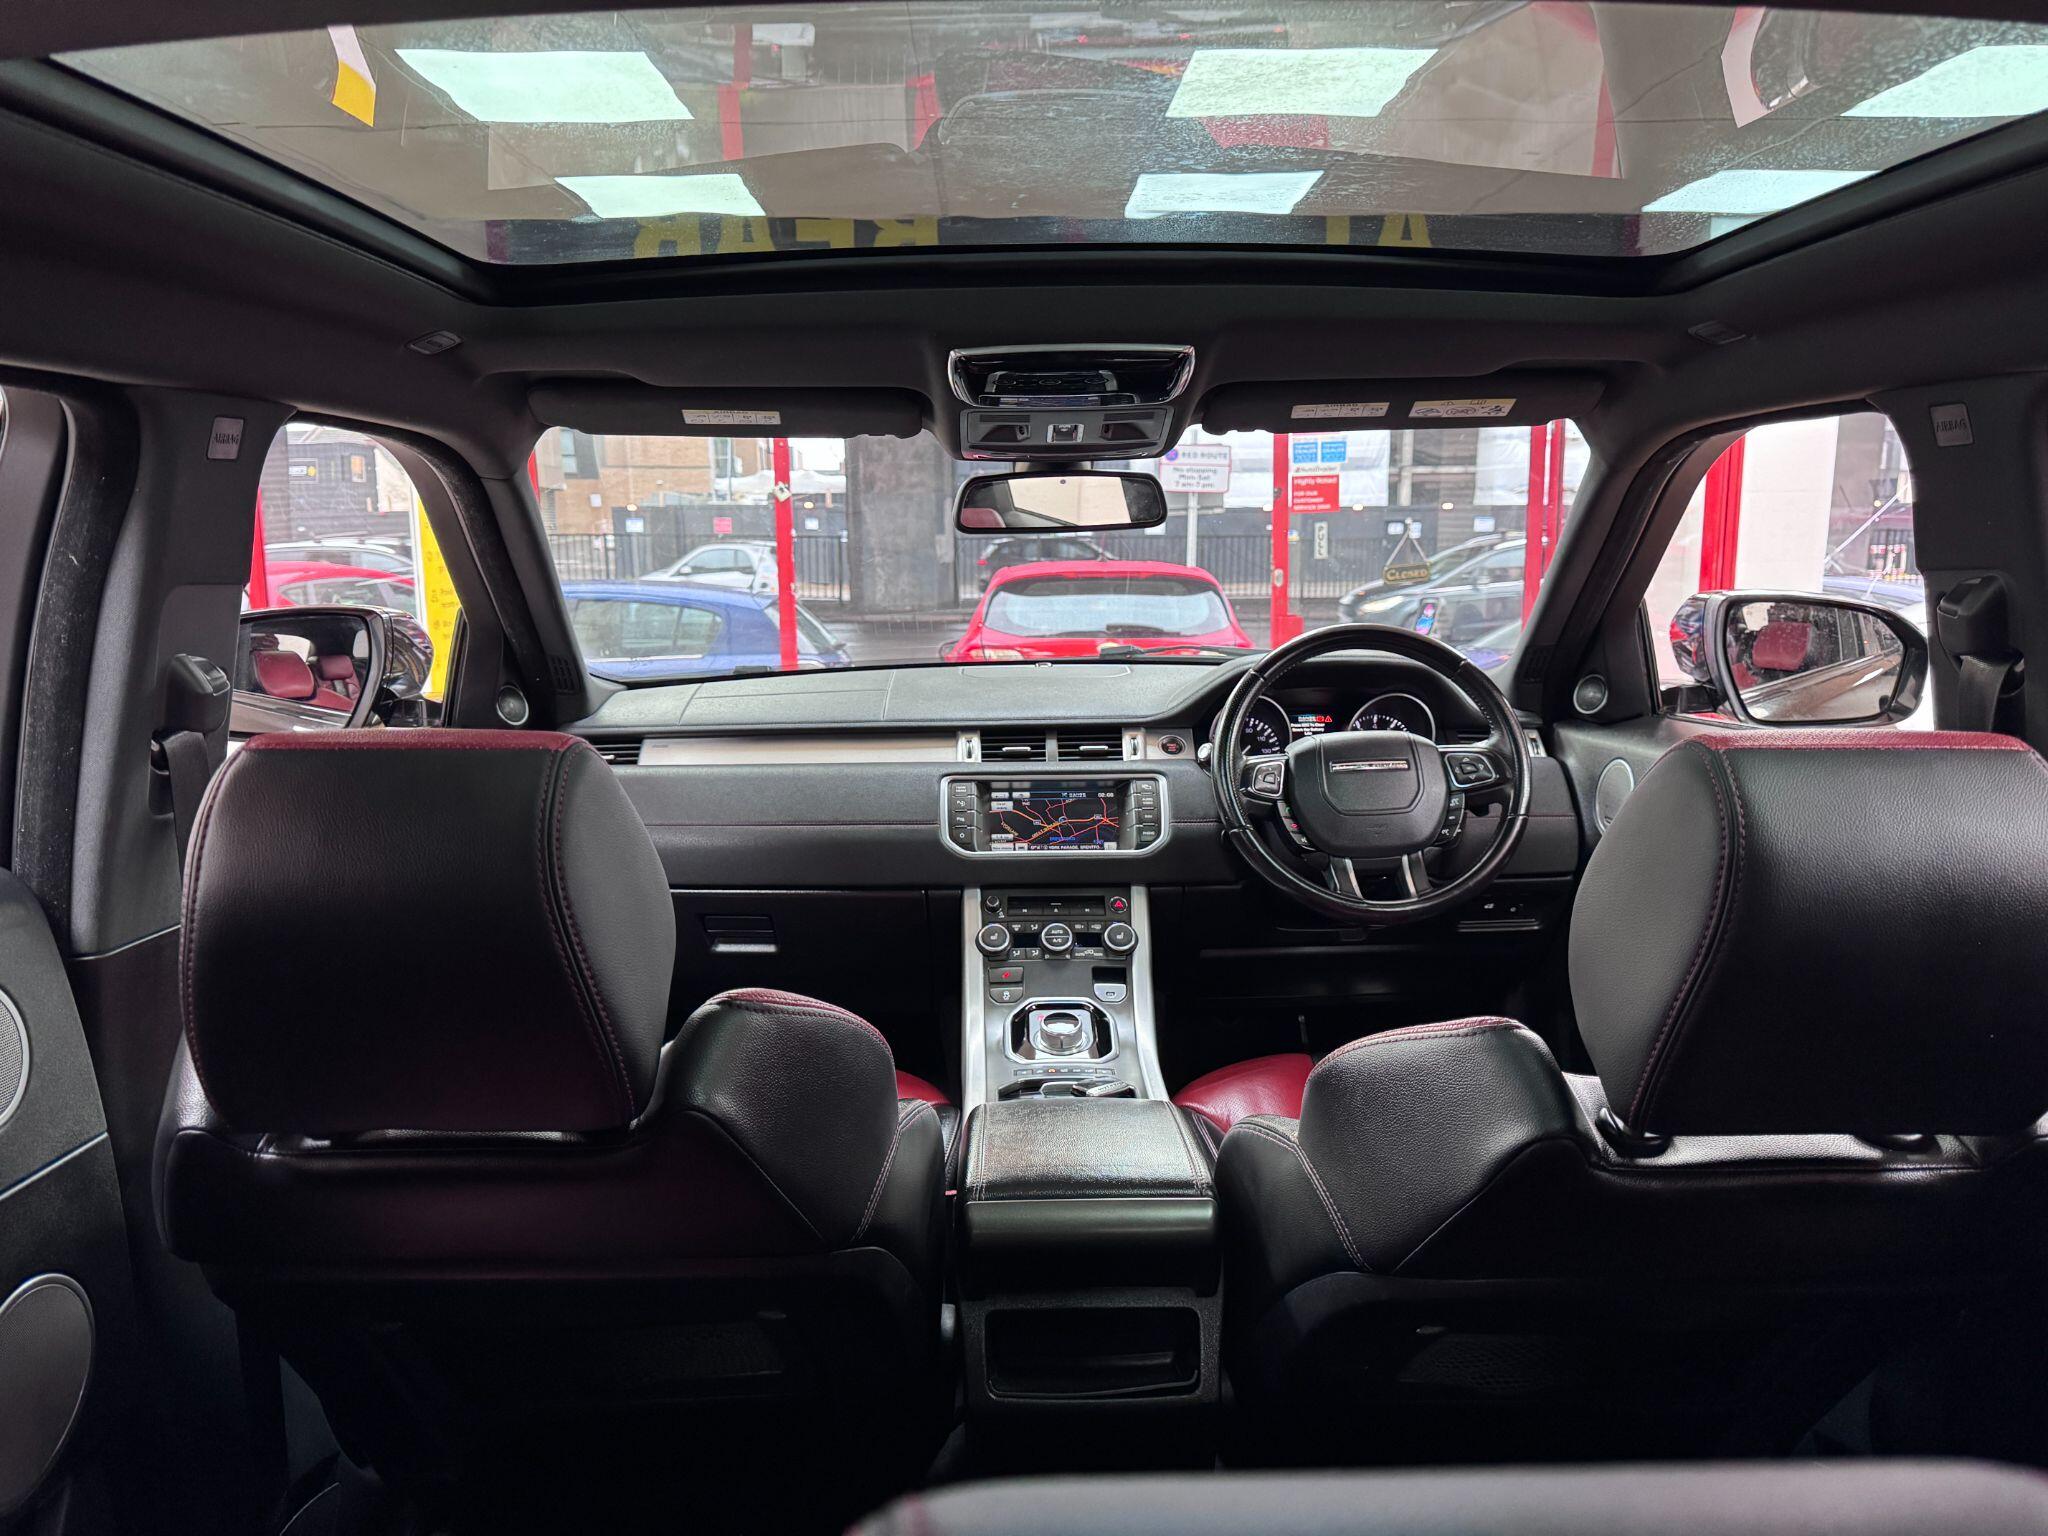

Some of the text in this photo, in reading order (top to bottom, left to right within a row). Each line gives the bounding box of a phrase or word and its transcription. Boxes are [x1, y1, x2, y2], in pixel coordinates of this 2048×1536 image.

[1936, 418, 1968, 433] AIRBAG
[1182, 451, 1227, 460] RED ROUTE
[1317, 525, 1325, 556] PULL
